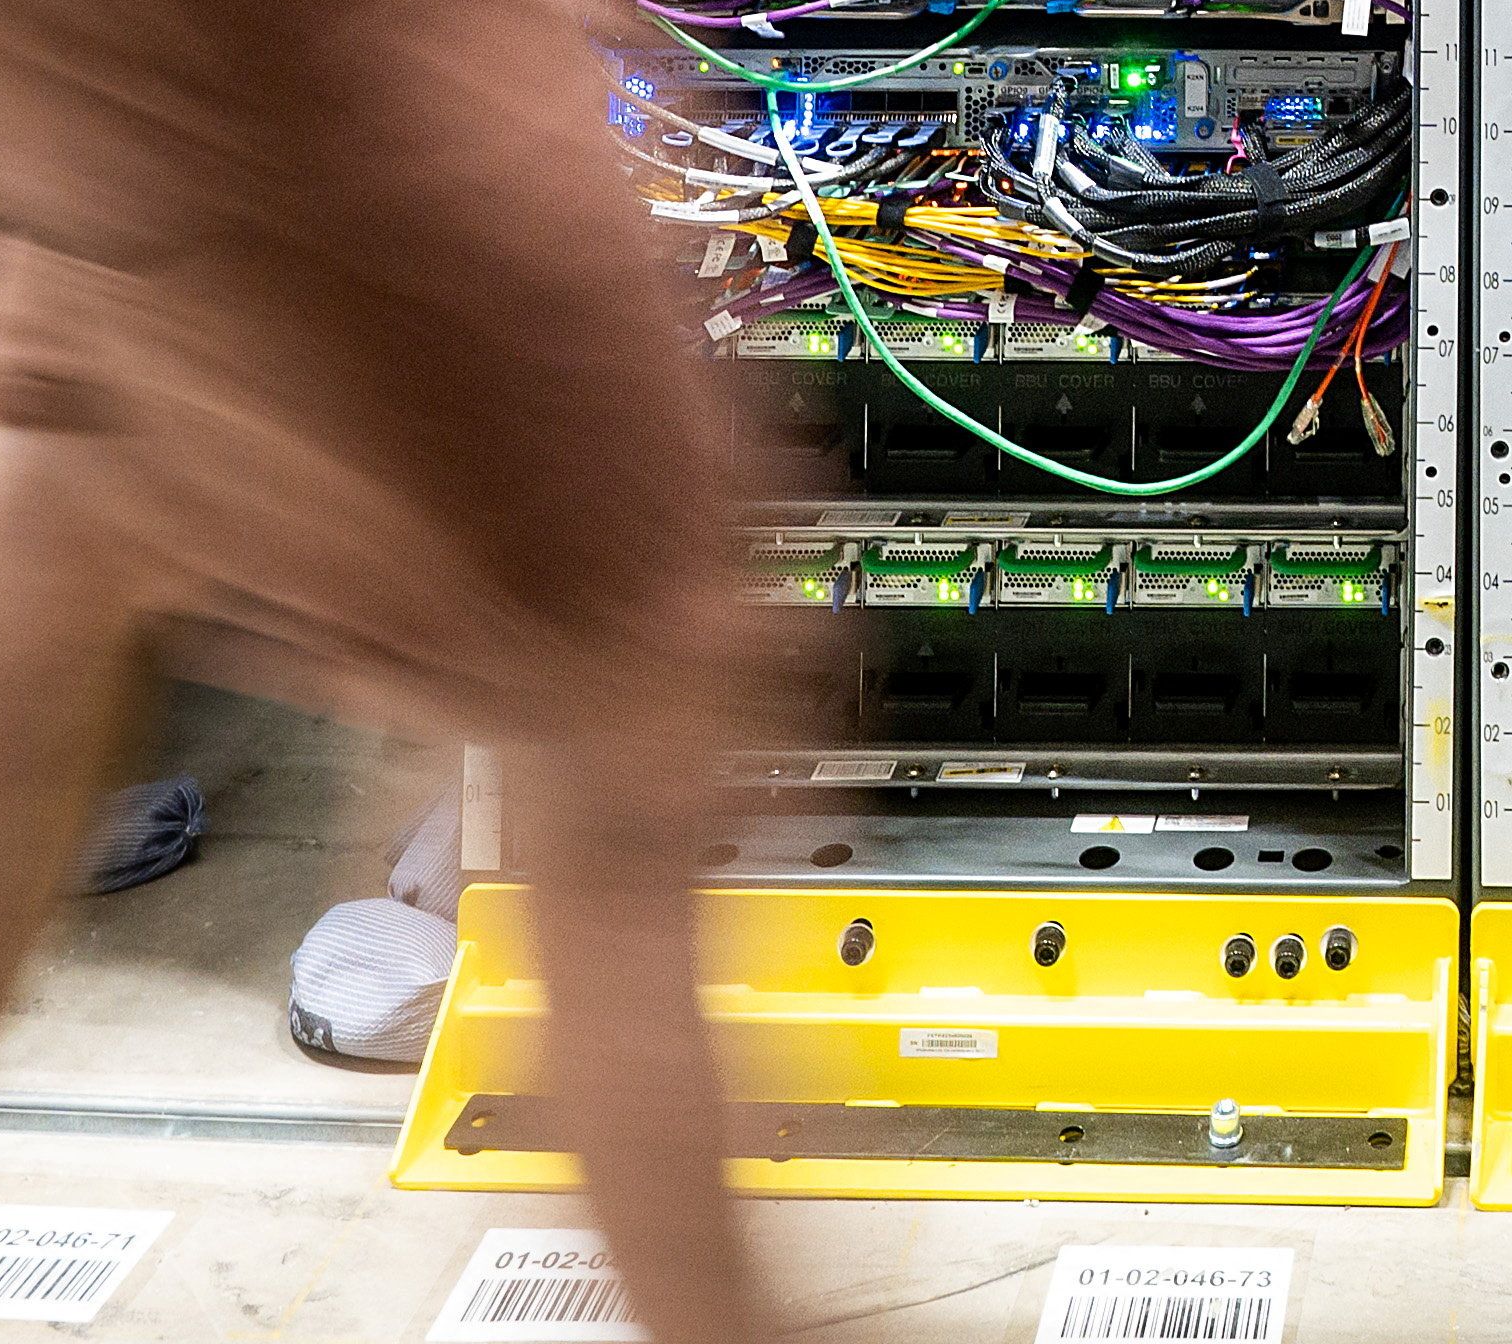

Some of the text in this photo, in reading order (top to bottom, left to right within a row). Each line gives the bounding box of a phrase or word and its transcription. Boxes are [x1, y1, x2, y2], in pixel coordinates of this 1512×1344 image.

[1446, 44, 1457, 61] 11
[1485, 49, 1496, 66] 11
[1443, 117, 1456, 135] 10
[1485, 123, 1498, 140] 10
[1484, 198, 1498, 214] 09
[1441, 267, 1455, 283] 08
[1484, 273, 1498, 289] 08
[1439, 340, 1454, 357] 07
[1483, 347, 1498, 364] 07
[1439, 415, 1454, 432] 06
[1438, 490, 1453, 507] 05
[1484, 499, 1498, 515] 05
[1437, 565, 1451, 582] 04
[1483, 572, 1498, 590] 04
[1437, 717, 1451, 733] 02
[1484, 724, 1499, 742] 02
[1437, 793, 1450, 811] 01
[1484, 800, 1497, 818] 01
[1079, 1269, 1272, 1287] 01-02-046-73
